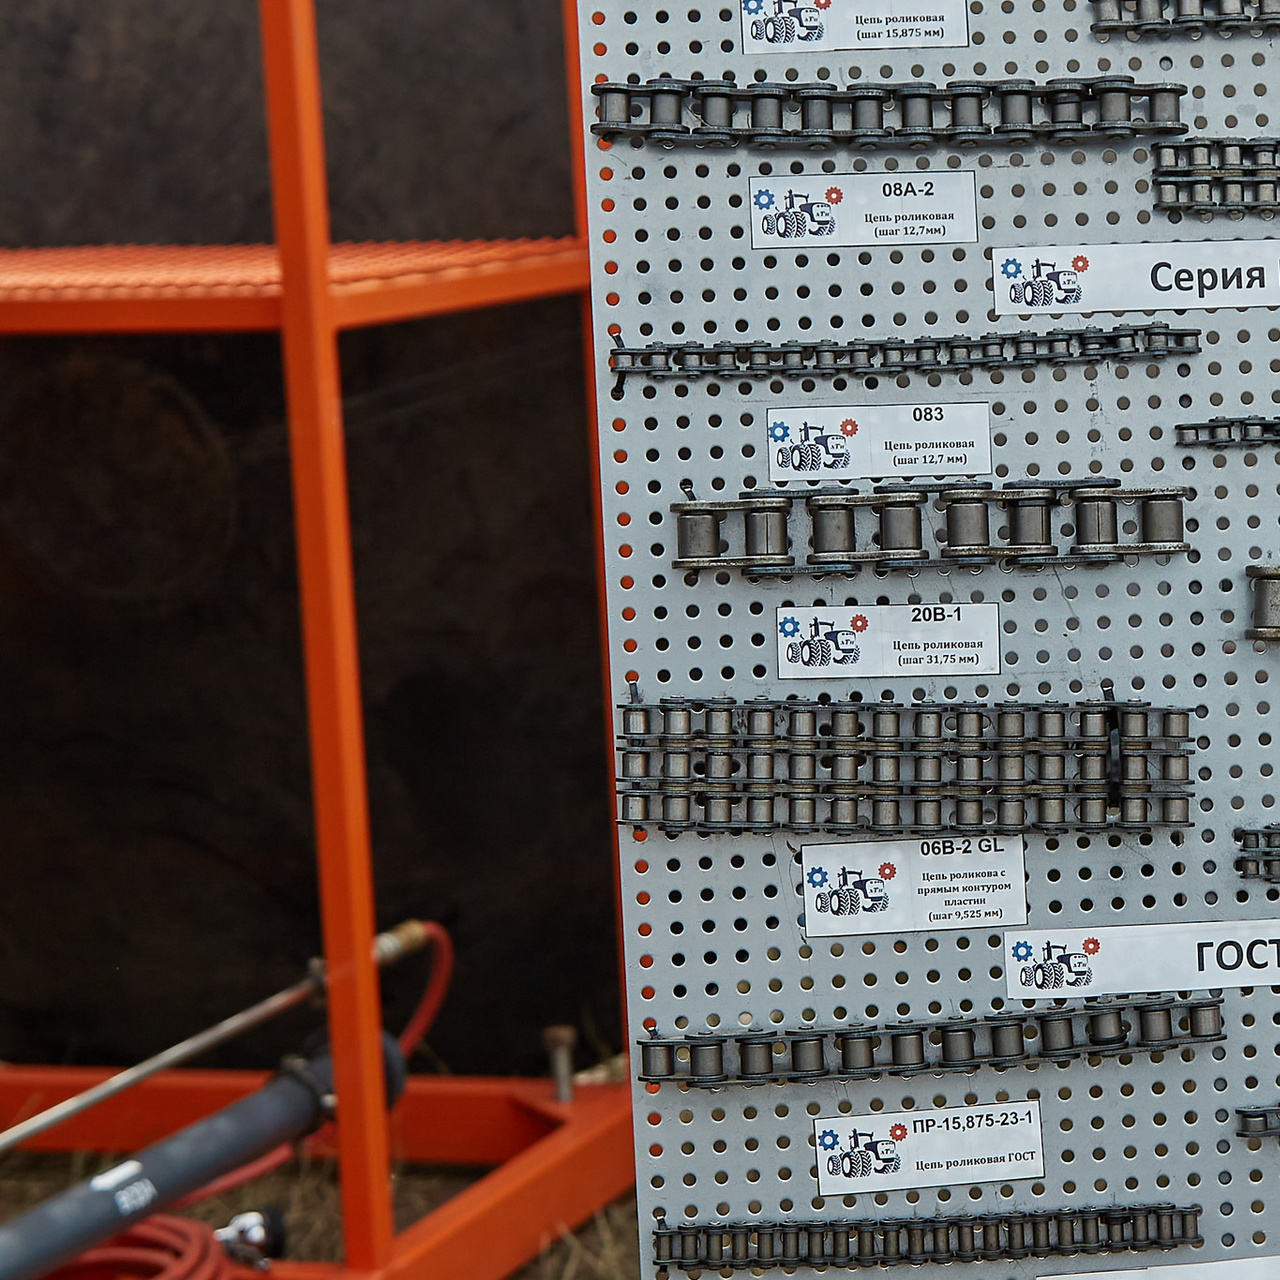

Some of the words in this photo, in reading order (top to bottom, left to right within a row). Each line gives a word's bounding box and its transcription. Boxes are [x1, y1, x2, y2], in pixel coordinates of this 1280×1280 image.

[855, 15, 883, 26] Цепь
[885, 15, 945, 26] роликовая
[857, 30, 883, 41] (шаг
[886, 28, 921, 39] 15,875
[924, 27, 944, 39] мм)
[882, 181, 934, 197] 08A-2
[865, 213, 892, 224] Цепь
[894, 213, 954, 224] роликовая
[874, 227, 900, 238] (шаг
[1150, 262, 1265, 298] Серия
[913, 407, 944, 422] 083
[884, 441, 912, 452] Цепь
[914, 441, 975, 452] роликовая
[893, 455, 919, 467] (шаг
[922, 454, 944, 465] 12,7
[947, 453, 967, 465] мм)
[911, 606, 961, 622] 20B-1
[893, 640, 921, 652] Цепь
[923, 641, 983, 652] роликовая
[898, 655, 924, 667] (шаг
[926, 654, 956, 665] 31,75
[959, 653, 979, 665] мм)
[921, 838, 973, 856] 06B-2
[977, 836, 1005, 853] GL
[922, 872, 947, 882] Цепь
[949, 871, 998, 882] роликова
[917, 886, 959, 897] прямым
[962, 883, 1011, 893] контуром
[944, 898, 986, 906] пластин
[928, 912, 953, 923] (шаг
[955, 909, 982, 920] 9,525
[984, 908, 1003, 919] мм)
[913, 1110, 1032, 1134] ПР-15,875-23-1
[916, 1161, 943, 1171] Цепь
[946, 1156, 1005, 1170] роликовая
[1008, 1151, 1036, 1162] ГОСТ
